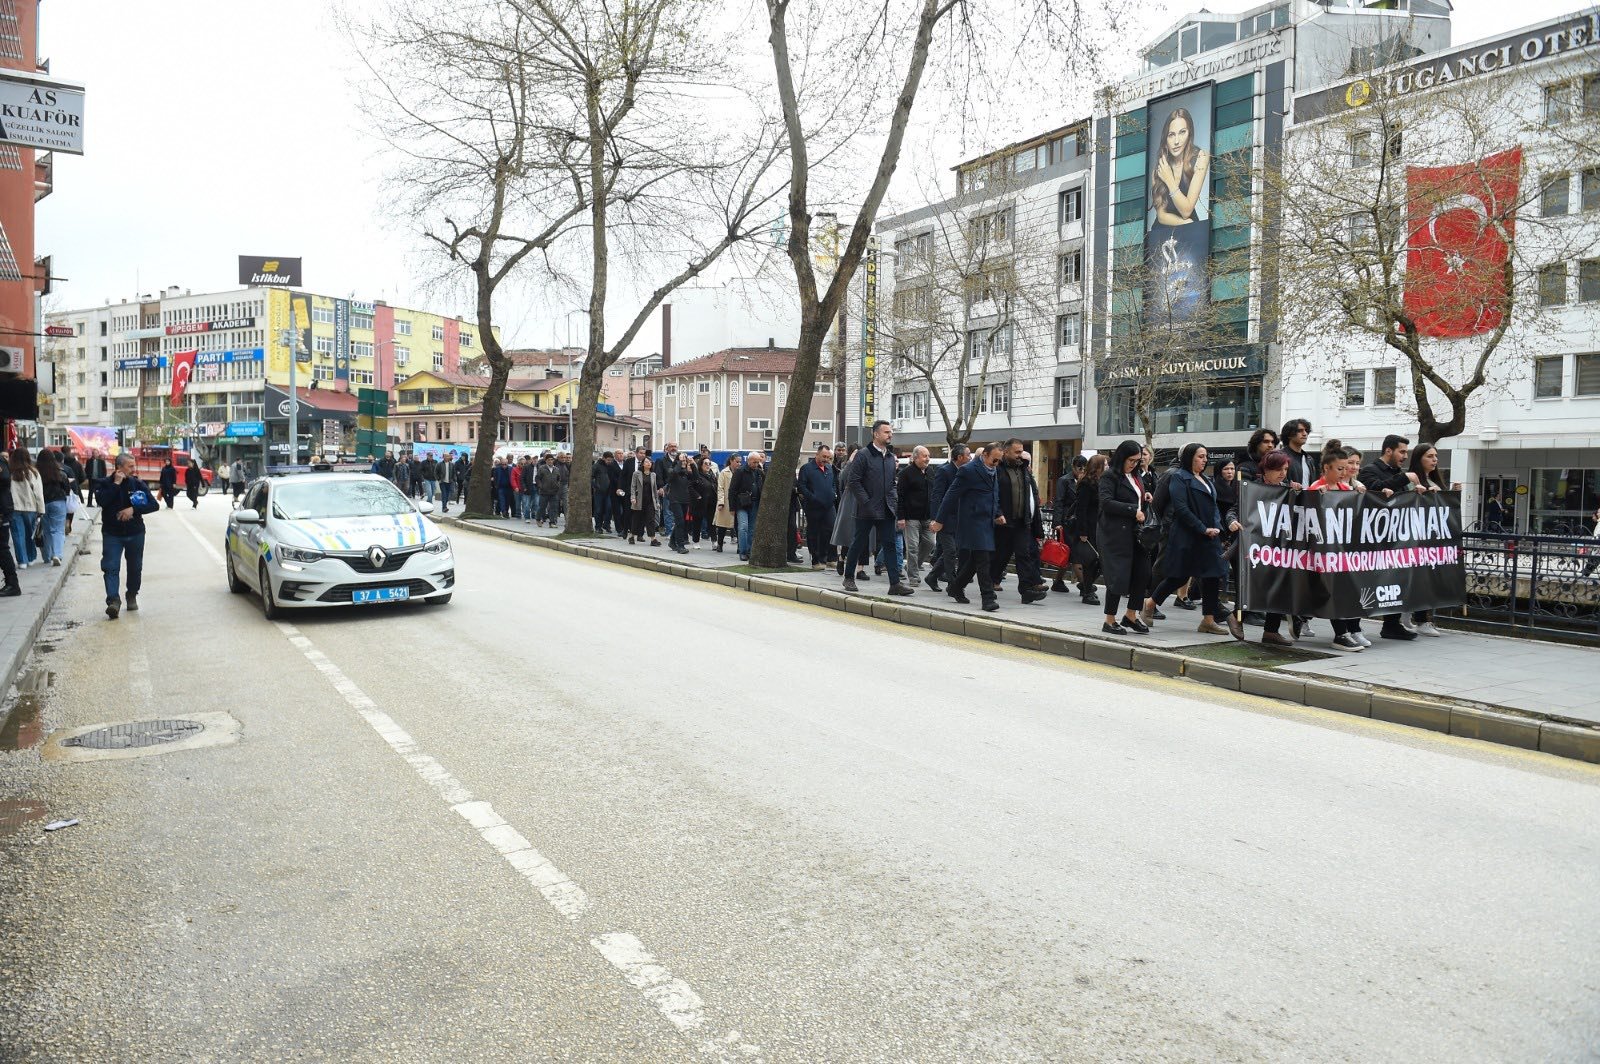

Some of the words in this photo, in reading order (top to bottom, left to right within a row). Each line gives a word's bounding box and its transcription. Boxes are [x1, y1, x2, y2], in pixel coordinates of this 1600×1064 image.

[1167, 40, 1281, 88] KUYUMCULUK
[27, 88, 57, 106] AS
[2, 104, 80, 127] KUAFÖR
[46, 129, 76, 138] SALONU
[46, 139, 72, 147] FATMA
[251, 273, 291, 284] istikbal
[1161, 356, 1247, 375] KUYUMCULUK
[1257, 500, 1353, 545] VATANI
[1360, 506, 1452, 544] KORUMAK
[1249, 543, 1345, 573] ÇOCUKLARI
[1346, 548, 1416, 572] KORUMAKLA
[1418, 546, 1459, 570] BAŞLAR!
[360, 591, 370, 601] 37
[389, 587, 408, 598] 5421
[1376, 584, 1401, 602] CHP
